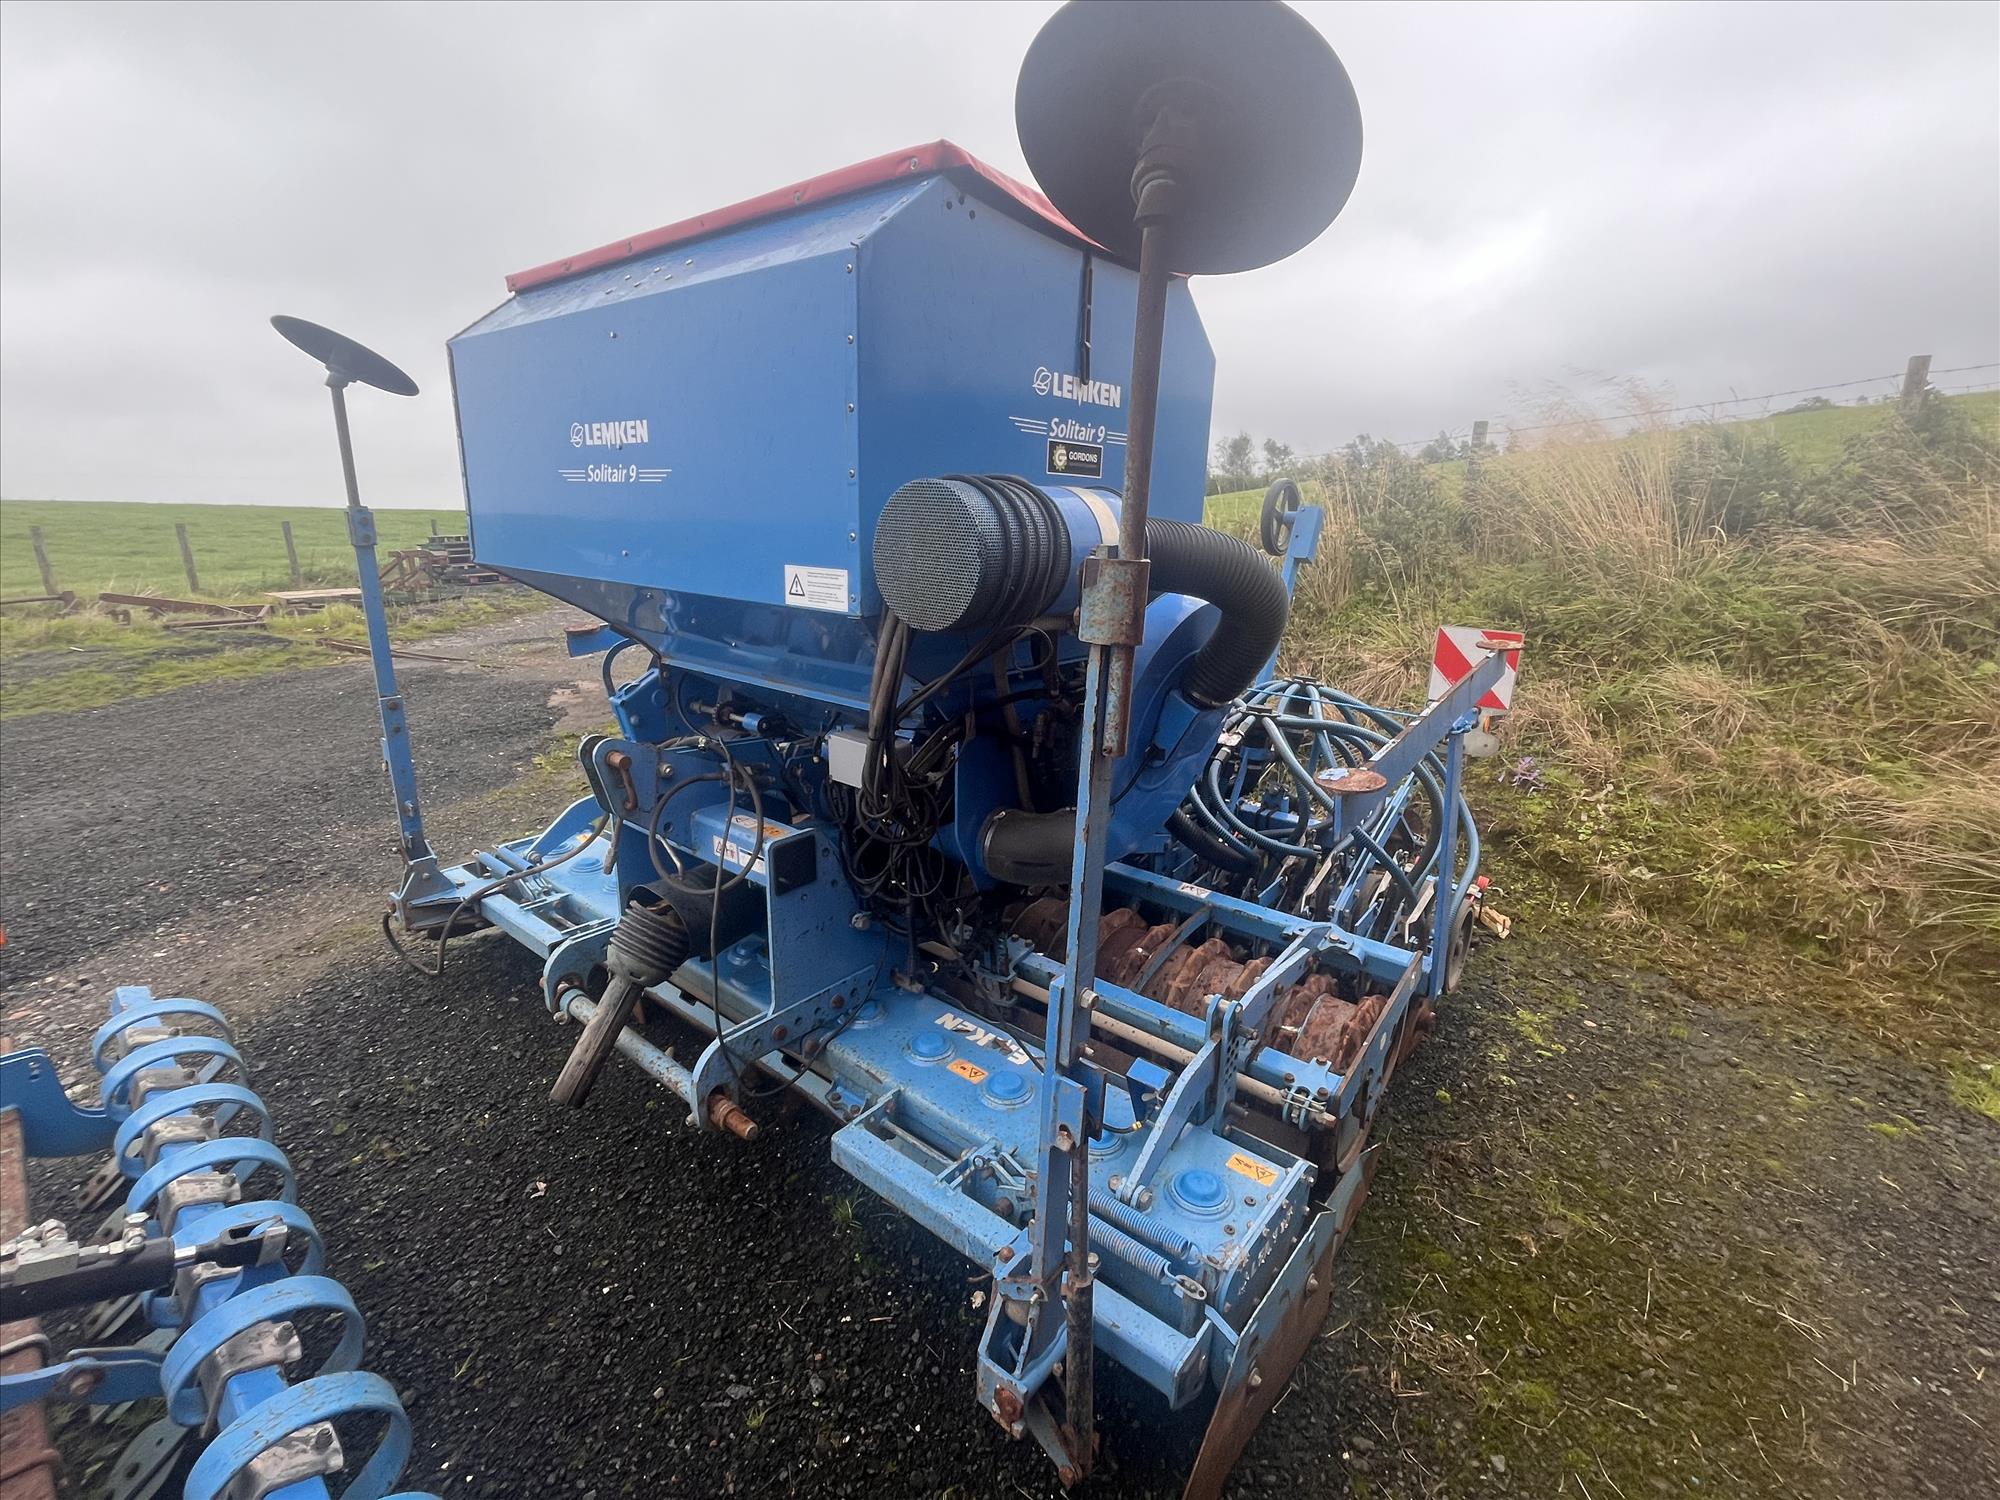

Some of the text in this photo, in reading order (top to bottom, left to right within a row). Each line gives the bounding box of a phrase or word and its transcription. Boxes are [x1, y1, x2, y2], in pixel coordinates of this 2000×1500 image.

[1052, 372, 1121, 408] LEMKEN
[584, 419, 649, 449] LEMKEN
[1049, 417, 1106, 443] Solitair 9
[1068, 451, 1098, 463] GORDONS
[587, 464, 637, 482] Solitair 9
